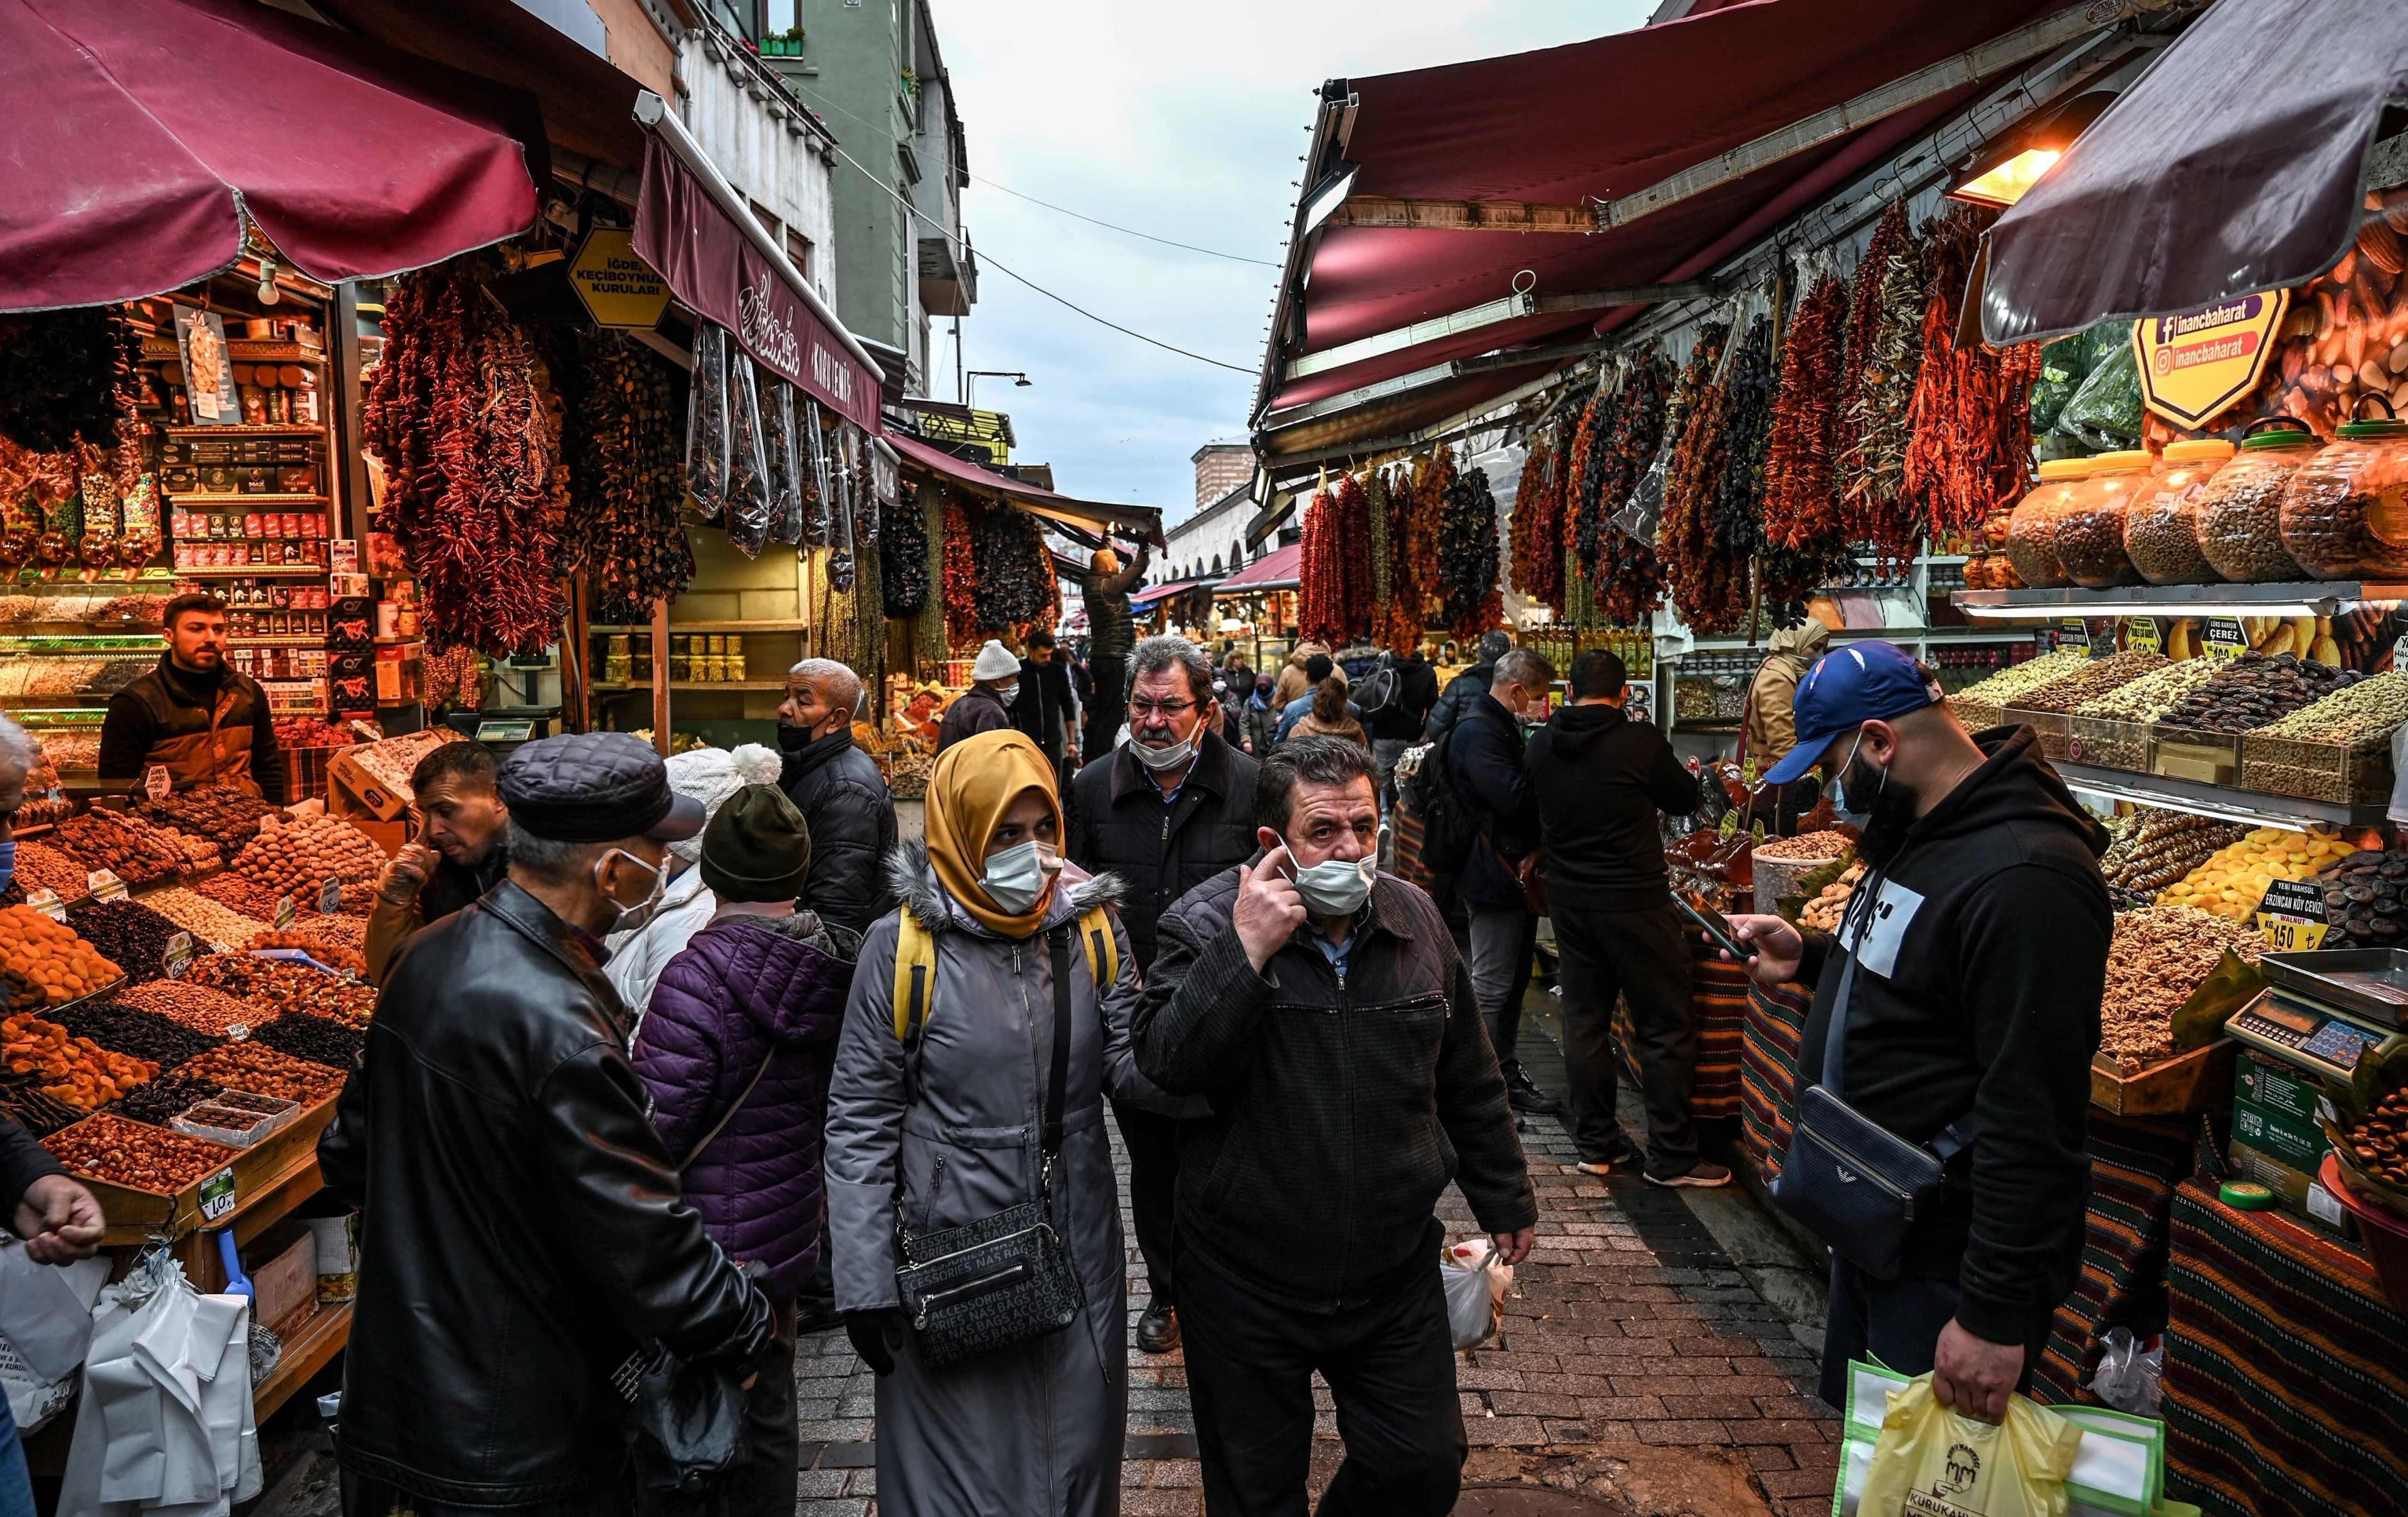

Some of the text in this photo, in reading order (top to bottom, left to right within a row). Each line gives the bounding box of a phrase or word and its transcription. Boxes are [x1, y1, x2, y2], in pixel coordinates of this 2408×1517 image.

[607, 257, 643, 272] İĞDE,
[576, 270, 664, 283] KEÇİBOYNUZ
[591, 283, 660, 295] KURULARI
[2177, 300, 2247, 334] inancbaharat
[2175, 336, 2243, 367] inancbaharat
[343, 600, 362, 613] Q7
[2210, 628, 2238, 640] ÇEREZ
[2221, 621, 2237, 630] KARIŞIK
[343, 657, 362, 669] Q7
[2278, 881, 2315, 894] YENİ MAHSÜL
[2265, 892, 2323, 914] ERZİNCAN KÖY CEVİZİ
[2280, 915, 2306, 925] WALNUT
[2264, 920, 2275, 930] KG.
[2274, 925, 2294, 949] 150
[172, 958, 185, 976] 65
[213, 1195, 226, 1215] 40
[909, 1203, 1037, 1252] CESSORIES NAS BAGS
[984, 1223, 1016, 1241] BAGS
[976, 1252, 1002, 1269] NAS
[931, 1276, 1042, 1321] ACCESSORIES NAS
[969, 1304, 996, 1321] NAS
[997, 1292, 1031, 1313] BAGS
